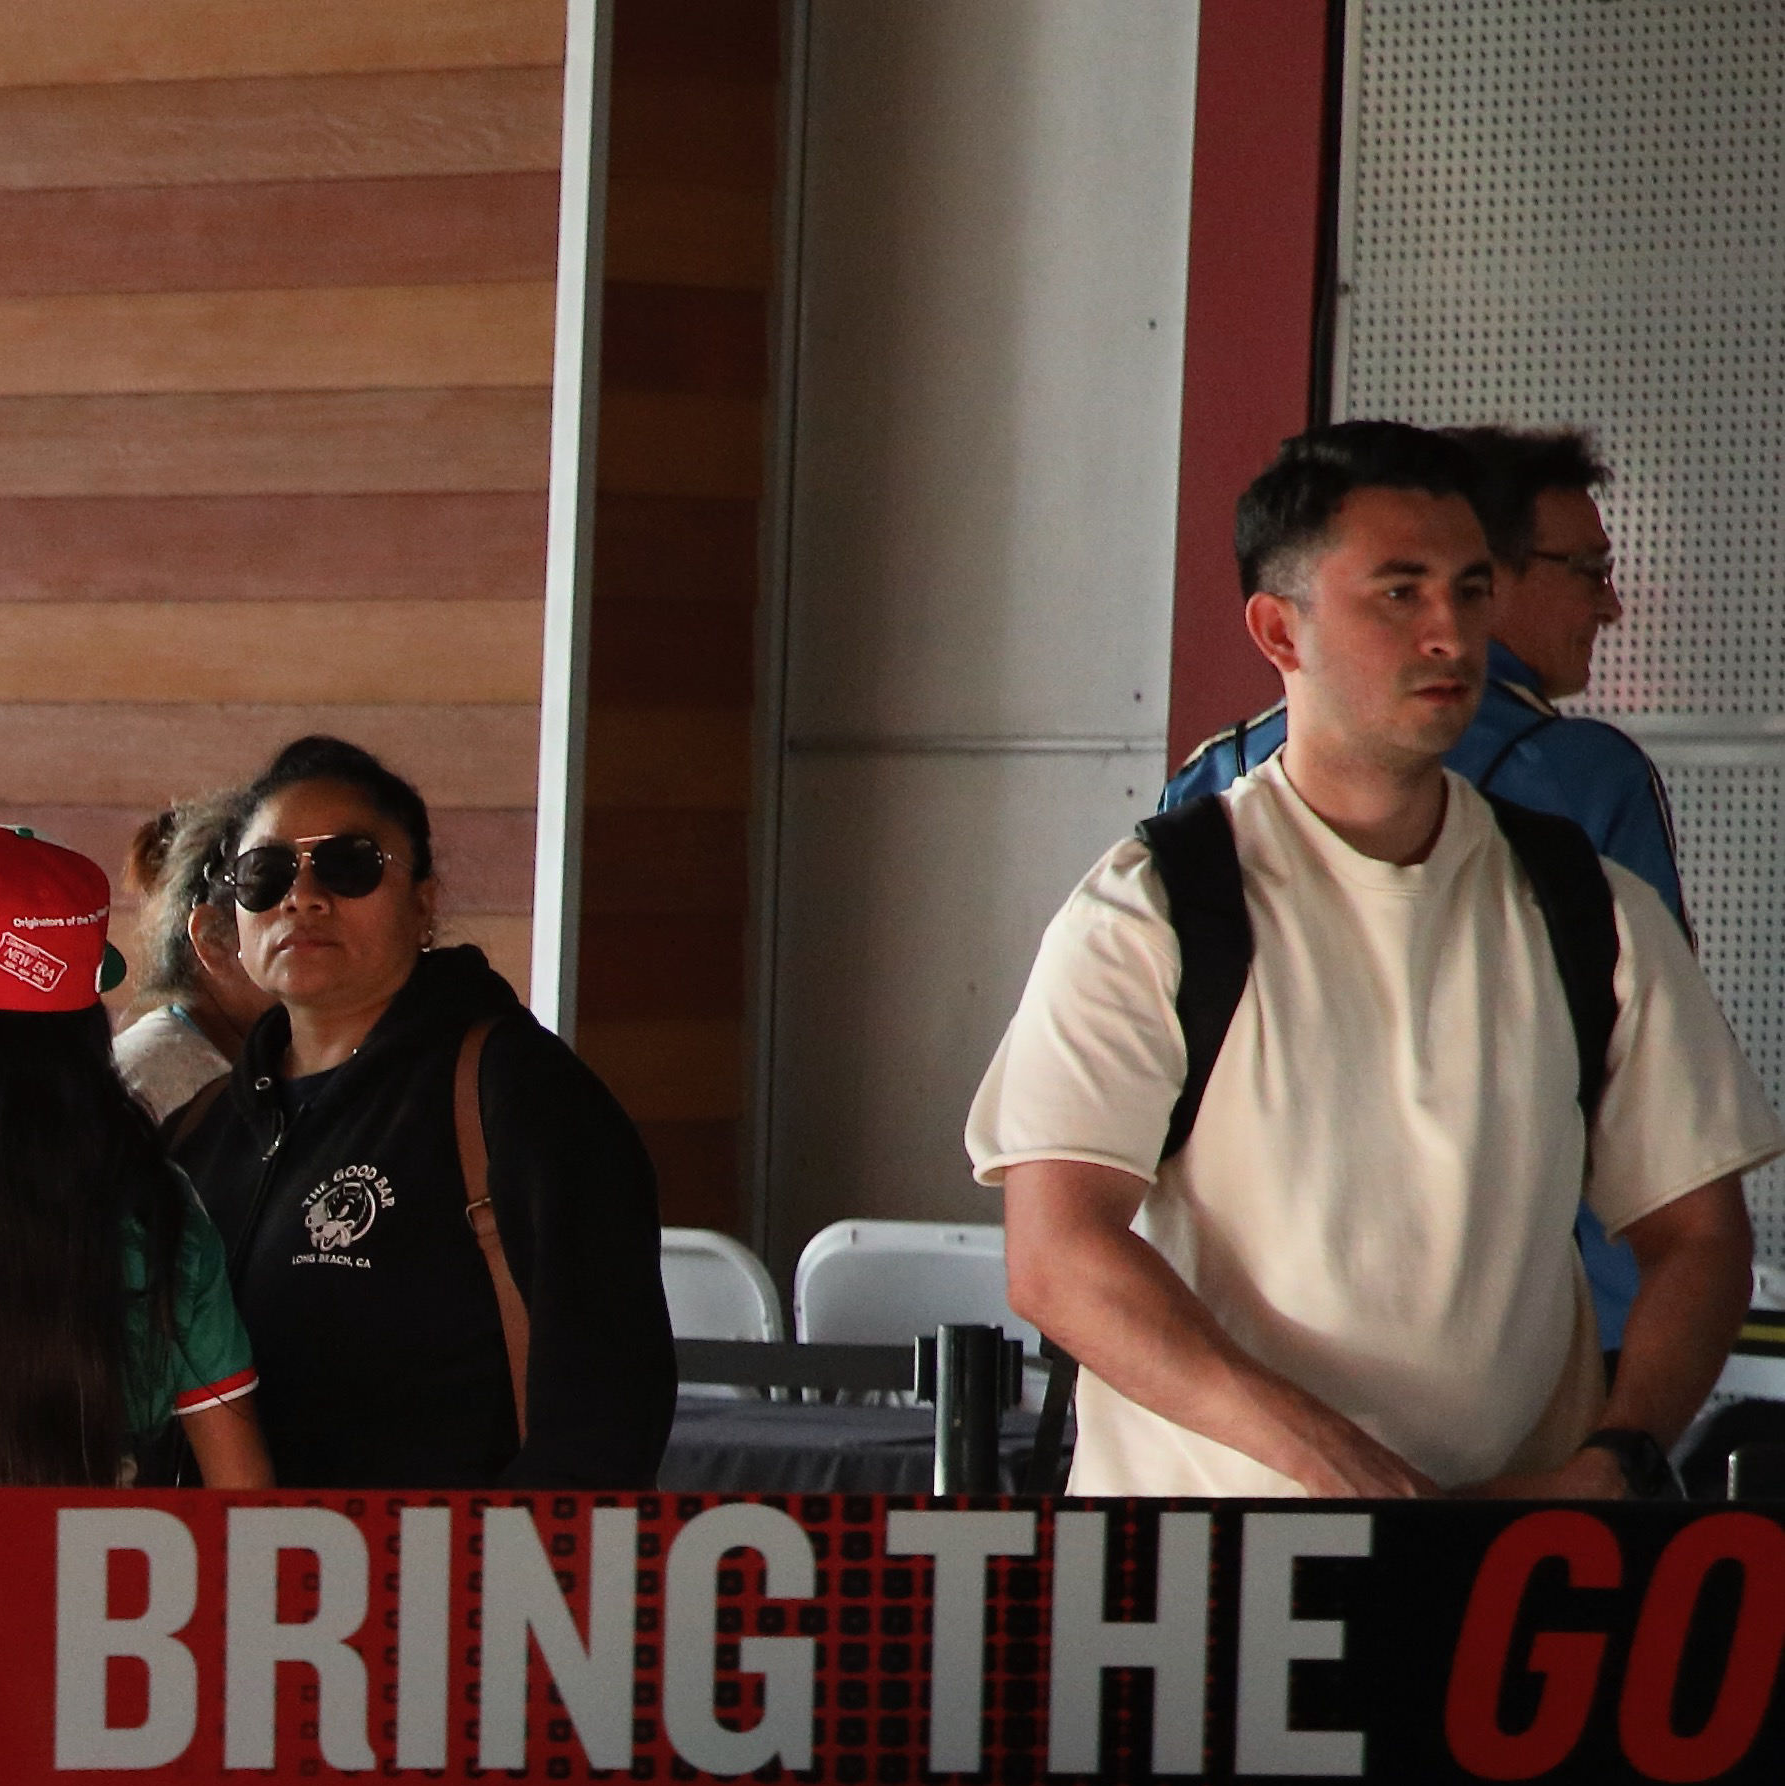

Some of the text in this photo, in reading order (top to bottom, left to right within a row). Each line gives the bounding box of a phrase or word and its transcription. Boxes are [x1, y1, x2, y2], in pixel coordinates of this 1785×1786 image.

[3, 947, 34, 969] NEW
[32, 961, 57, 982] ERA
[333, 1165, 378, 1183] GOOD
[374, 1176, 395, 1209] BAR
[292, 1253, 316, 1266] LONG
[355, 1257, 371, 1269] CA
[54, 1501, 818, 1777] BRING
[884, 1510, 1374, 1777] THE
